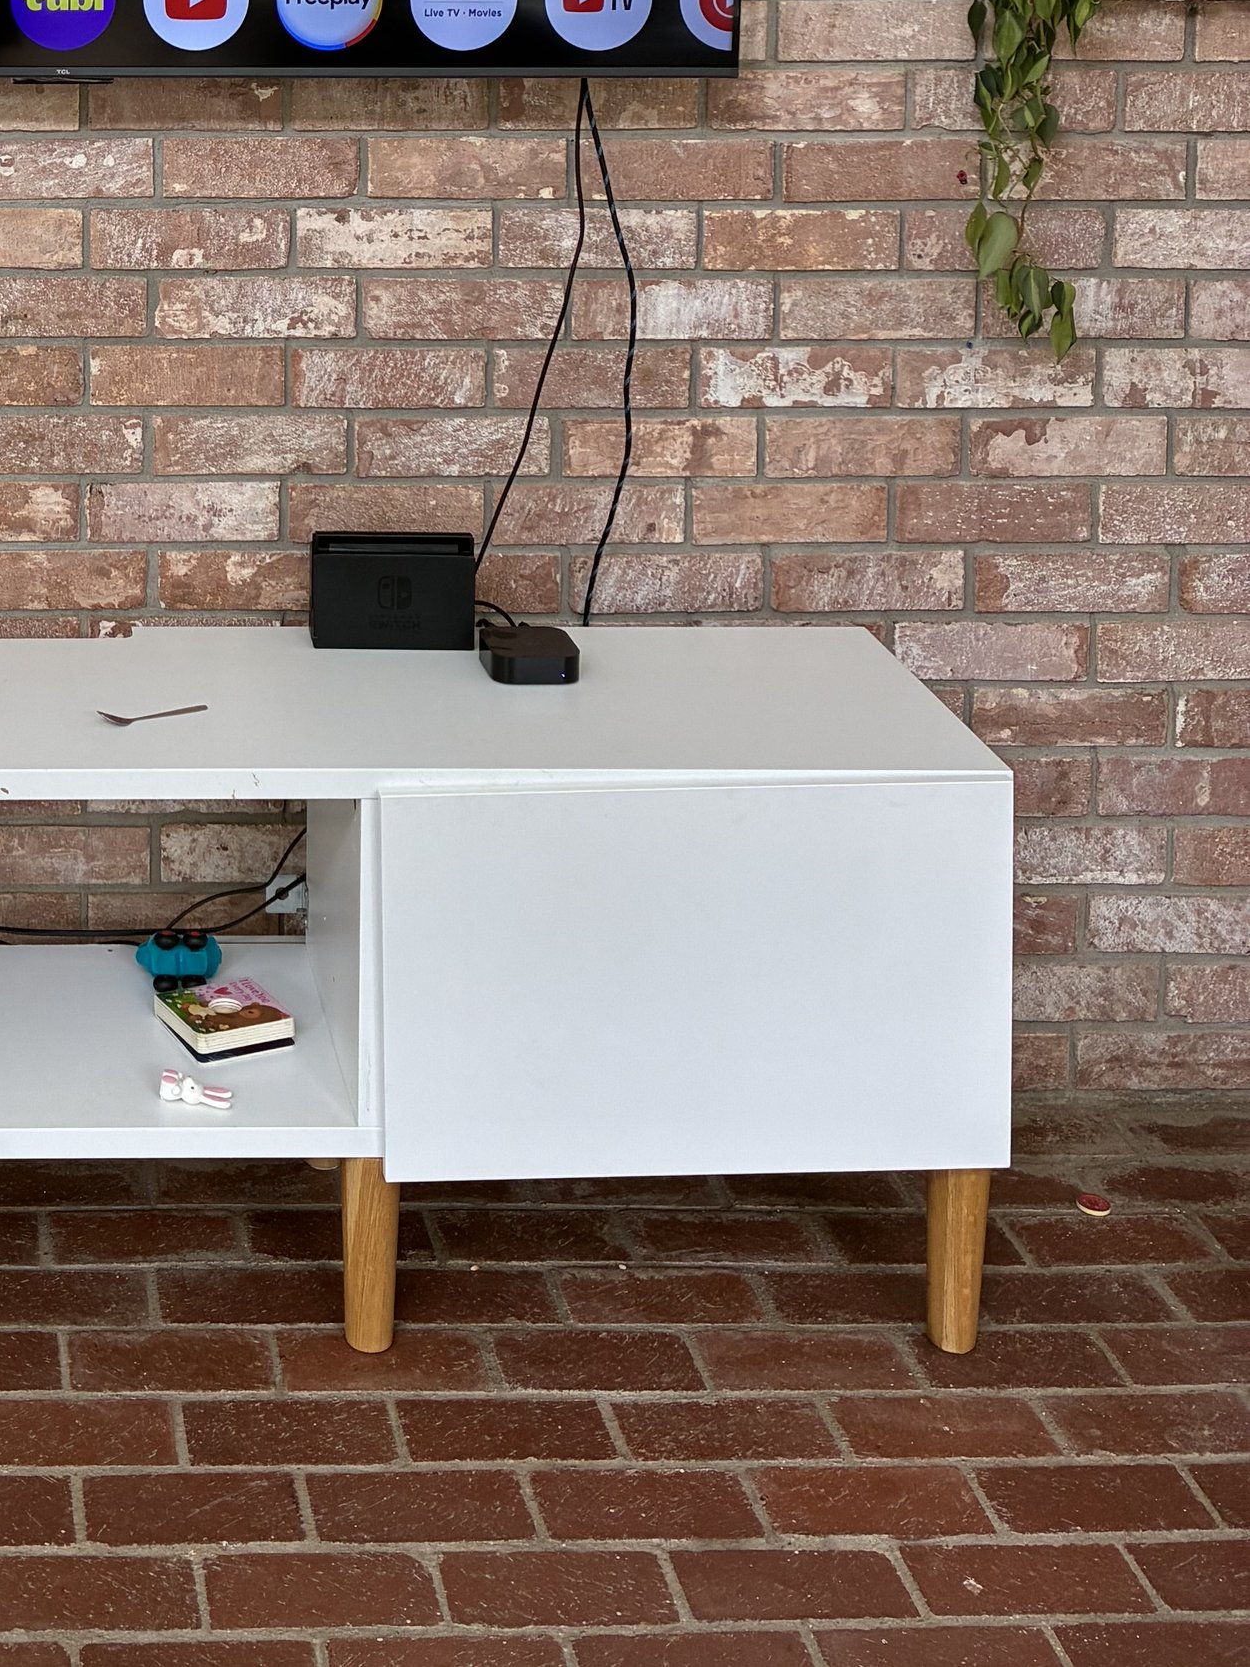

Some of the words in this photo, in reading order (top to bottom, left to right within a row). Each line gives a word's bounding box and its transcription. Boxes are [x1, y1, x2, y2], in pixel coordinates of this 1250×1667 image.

[424, 8, 445, 18] Live
[447, 8, 460, 18] TV
[468, 8, 502, 18] Movies
[56, 68, 71, 76] TCL
